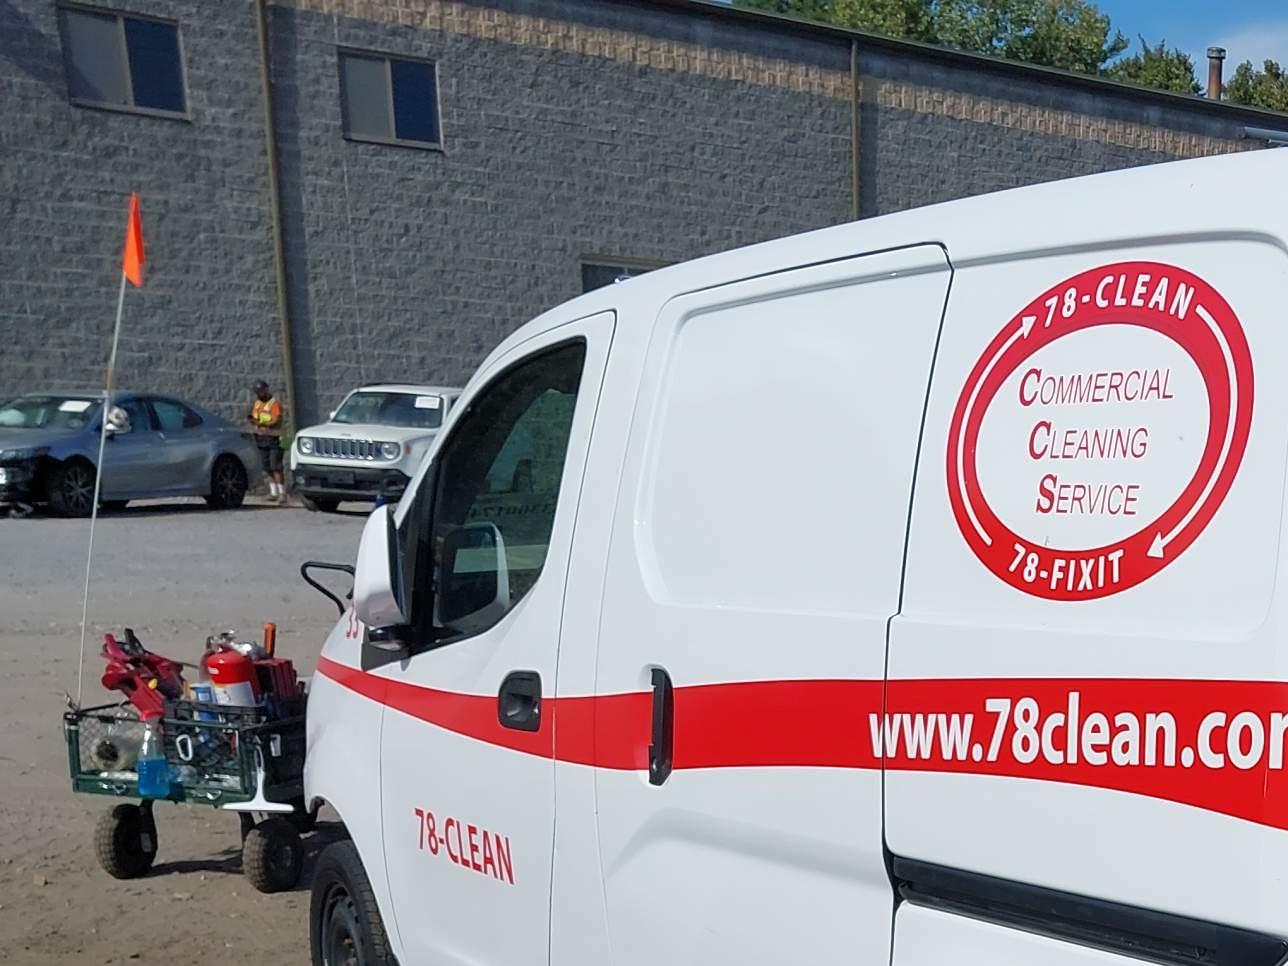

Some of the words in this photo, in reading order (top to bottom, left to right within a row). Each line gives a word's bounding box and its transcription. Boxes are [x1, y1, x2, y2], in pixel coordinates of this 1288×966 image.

[1044, 273, 1195, 327] 78-CLEAN
[1019, 368, 1174, 406] COMMERCIAL
[1029, 421, 1149, 460] CLEANING
[1035, 474, 1140, 515] SERVICE
[1008, 543, 1125, 592] 78-FIXIT
[415, 807, 515, 885] 78-CLEAN
